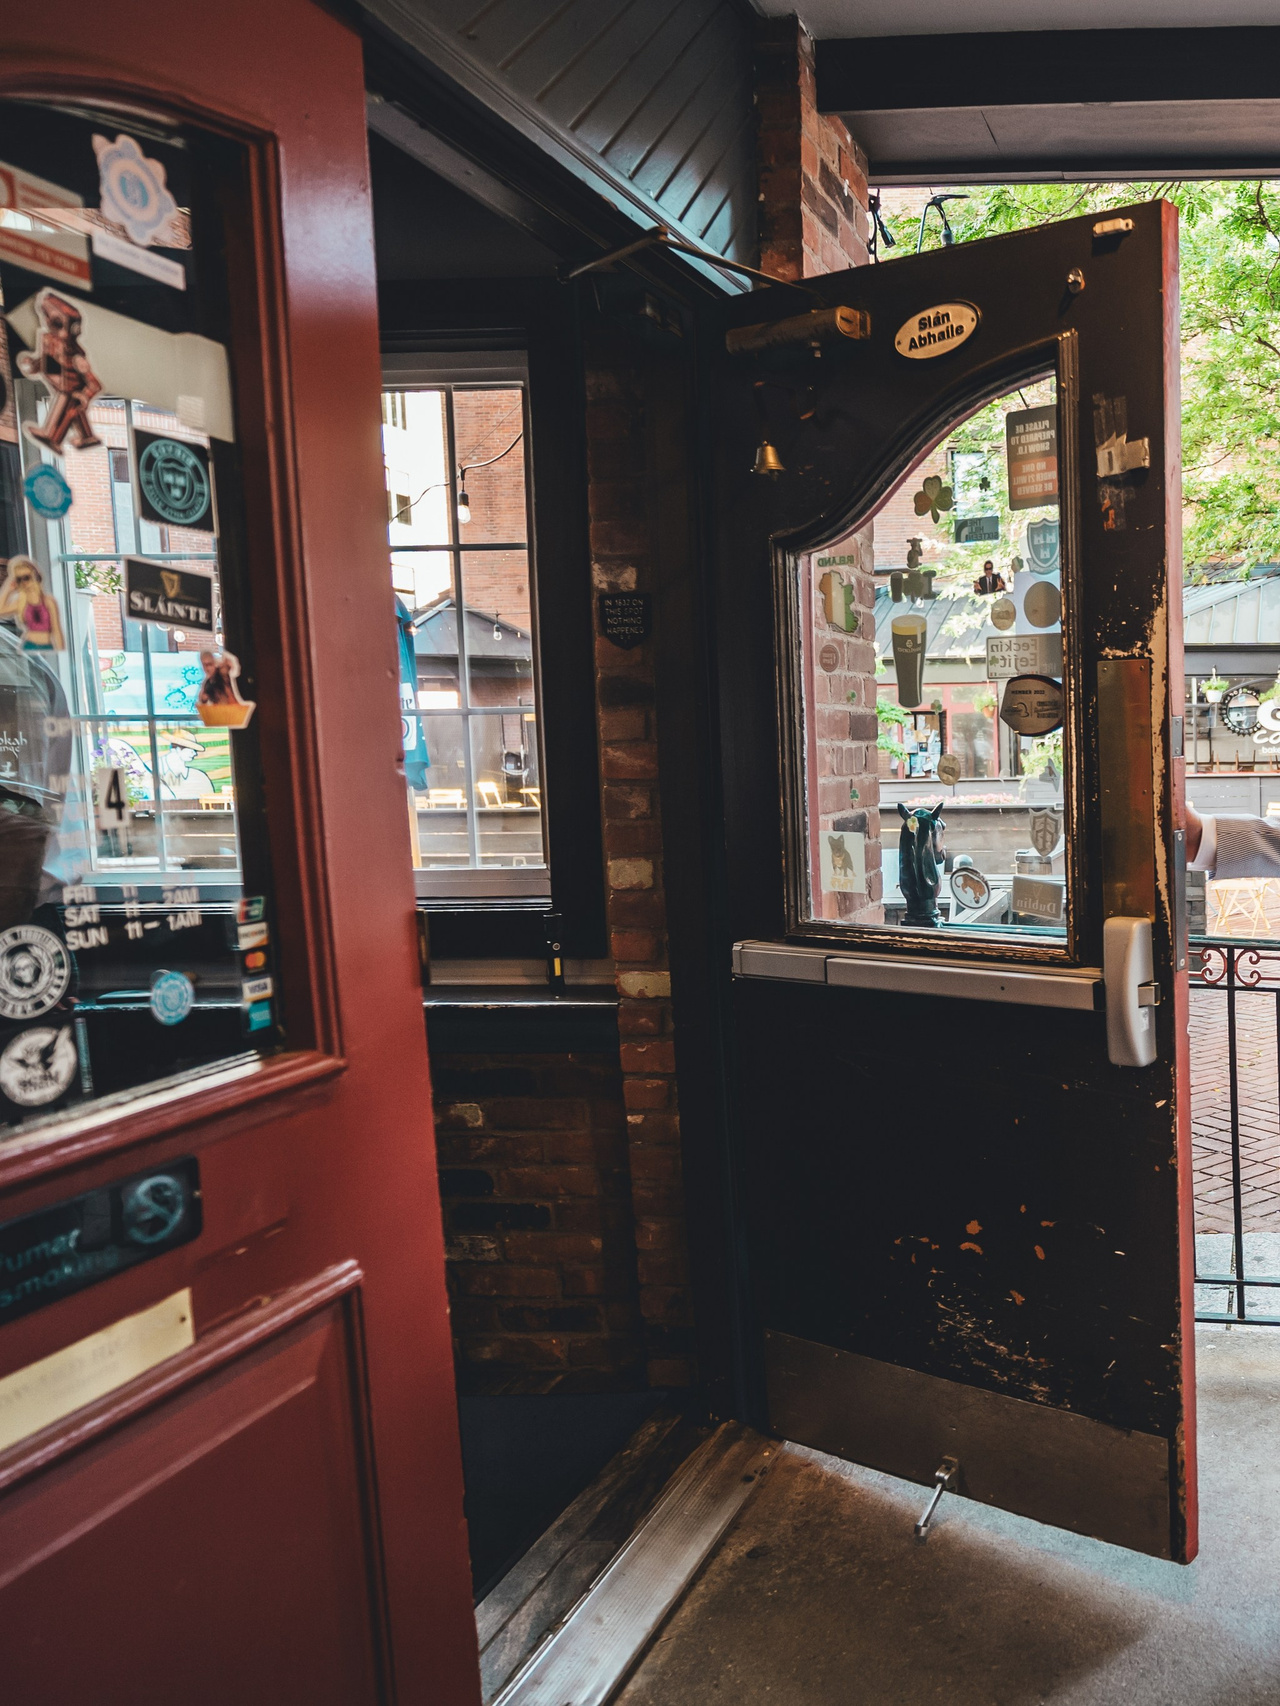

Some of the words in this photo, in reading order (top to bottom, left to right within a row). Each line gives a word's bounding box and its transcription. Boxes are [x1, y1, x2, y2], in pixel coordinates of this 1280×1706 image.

[908, 323, 965, 352] Abhaile
[607, 626, 644, 634] HAPPENED
[105, 769, 125, 820] 4
[63, 885, 97, 904] FRI
[64, 904, 101, 928] SAT
[161, 887, 200, 905] 2AM
[65, 926, 109, 951] SUN
[124, 920, 143, 940] 11
[166, 911, 202, 931] 1AM
[0, 1229, 81, 1273] umar
